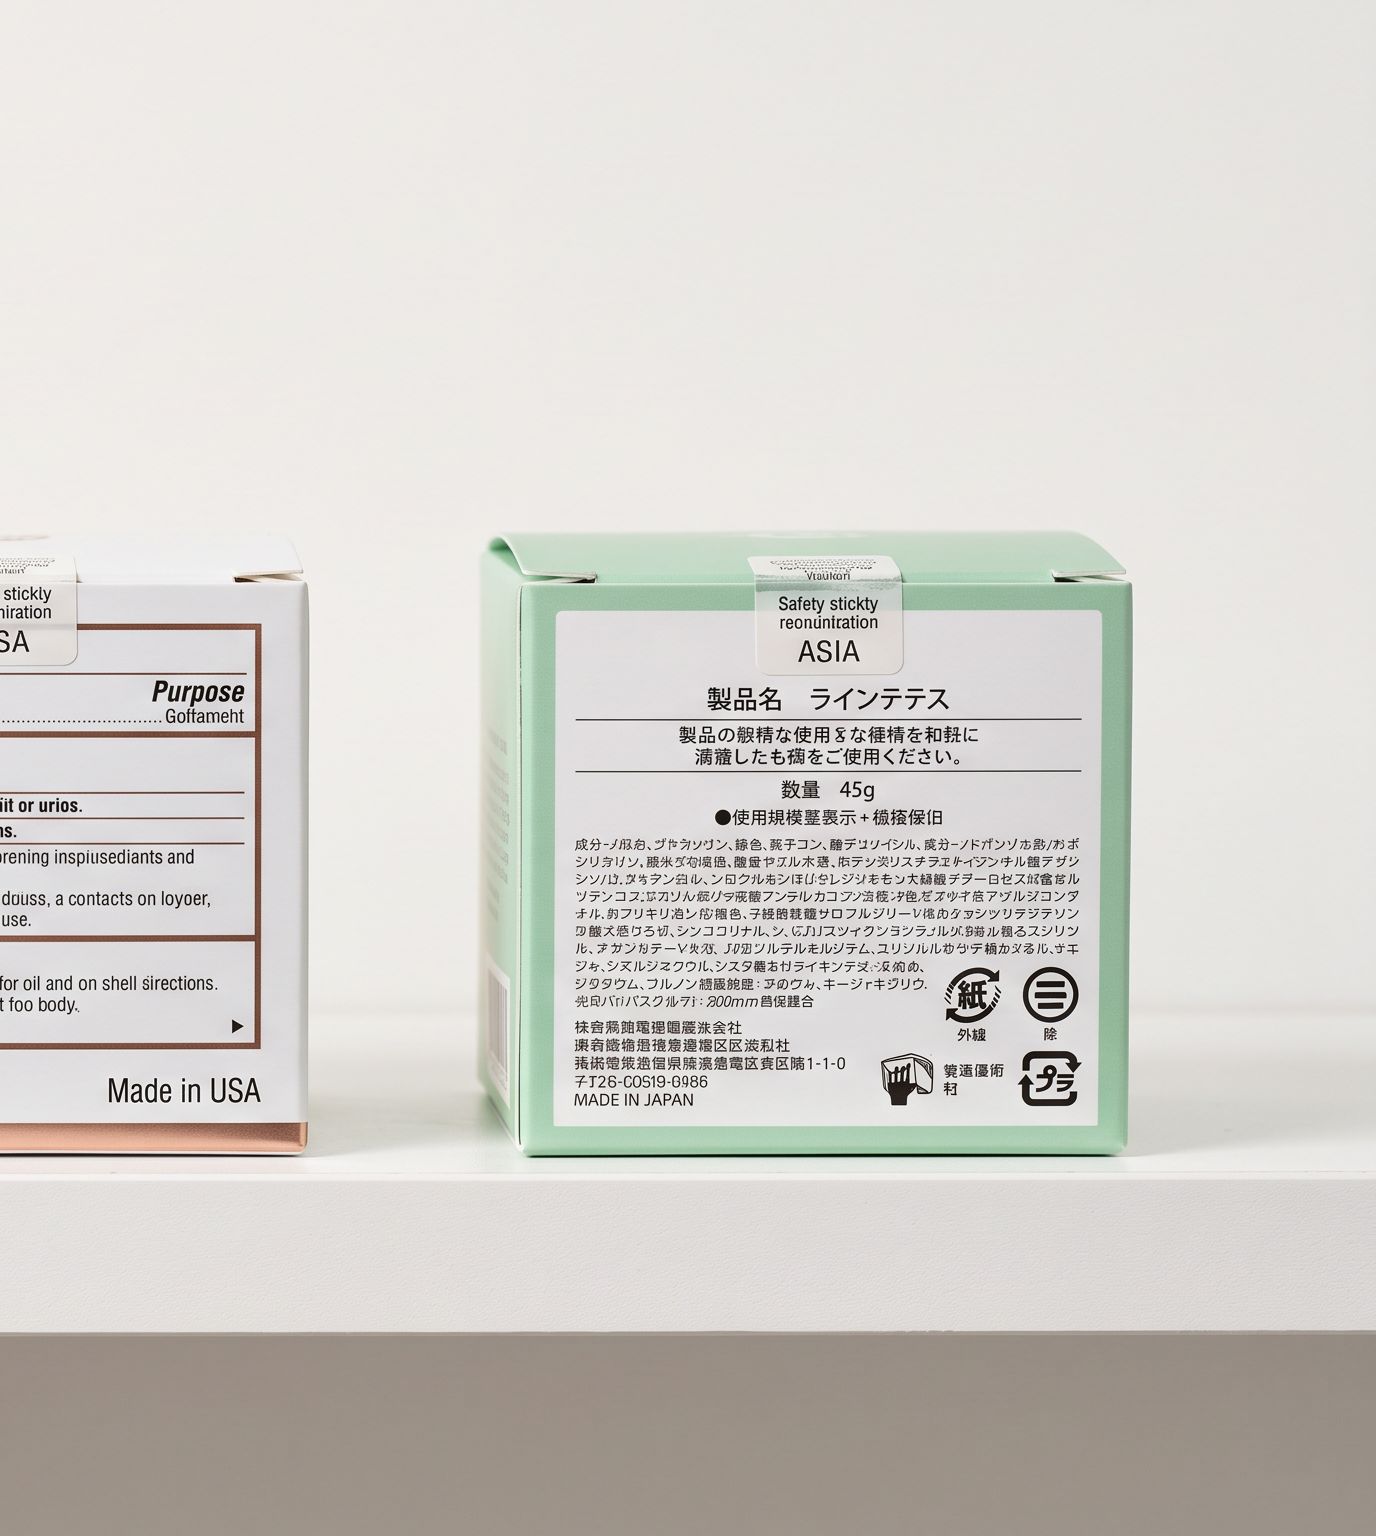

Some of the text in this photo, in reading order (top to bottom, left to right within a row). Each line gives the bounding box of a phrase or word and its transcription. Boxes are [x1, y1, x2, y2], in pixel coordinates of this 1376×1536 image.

[3, 586, 52, 604] stickly
[778, 595, 825, 615] Safety
[797, 639, 860, 663] ASIA
[151, 679, 245, 708] Purpose
[707, 686, 950, 712] 製品名 ラインテテス
[781, 779, 875, 803] 数量 45g
[18, 800, 35, 813] or
[38, 797, 83, 813] urios.
[167, 848, 195, 865] and
[55, 893, 64, 906] a
[68, 891, 133, 907] contacts
[137, 893, 156, 906] on
[161, 890, 211, 910] loyoer,
[23, 975, 40, 992] oil
[45, 975, 73, 991] and
[78, 978, 97, 991] on
[102, 975, 137, 991] shell
[8, 996, 34, 1013] foo
[957, 979, 988, 1010] 紙
[1034, 1063, 1076, 1093] プラ
[108, 1077, 261, 1104] Made in USA
[574, 1093, 694, 1107] MADE IN JAPAN
